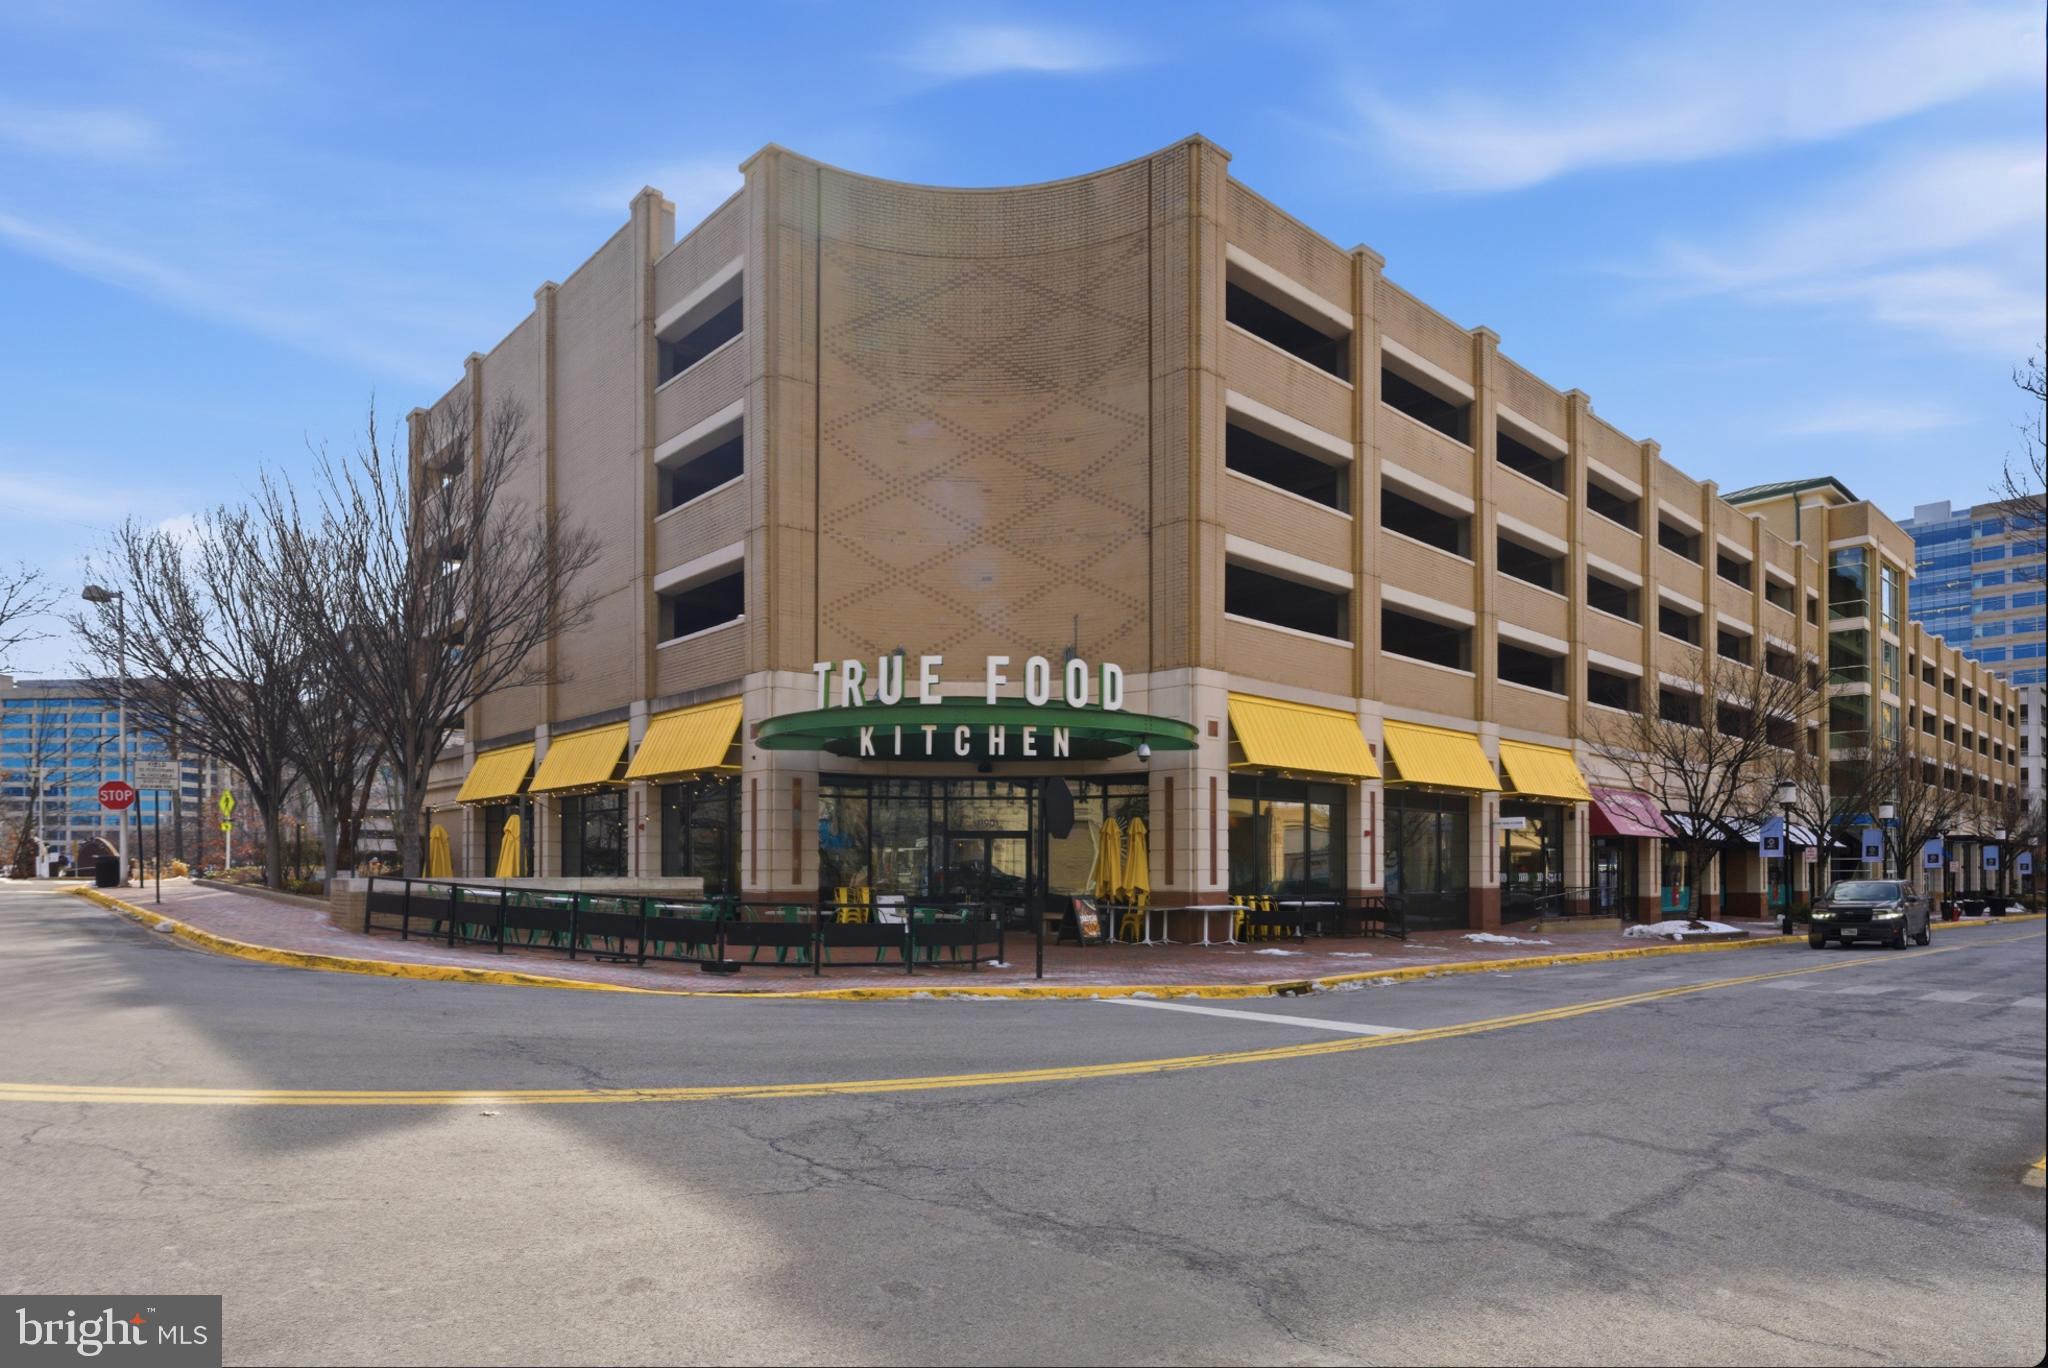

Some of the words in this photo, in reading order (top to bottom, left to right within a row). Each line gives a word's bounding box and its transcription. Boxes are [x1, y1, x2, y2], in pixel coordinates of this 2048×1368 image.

[813, 655, 943, 709] TRUE
[986, 655, 1124, 711] FOOD
[860, 724, 1070, 757] KITCHEN
[100, 790, 133, 802] STOP
